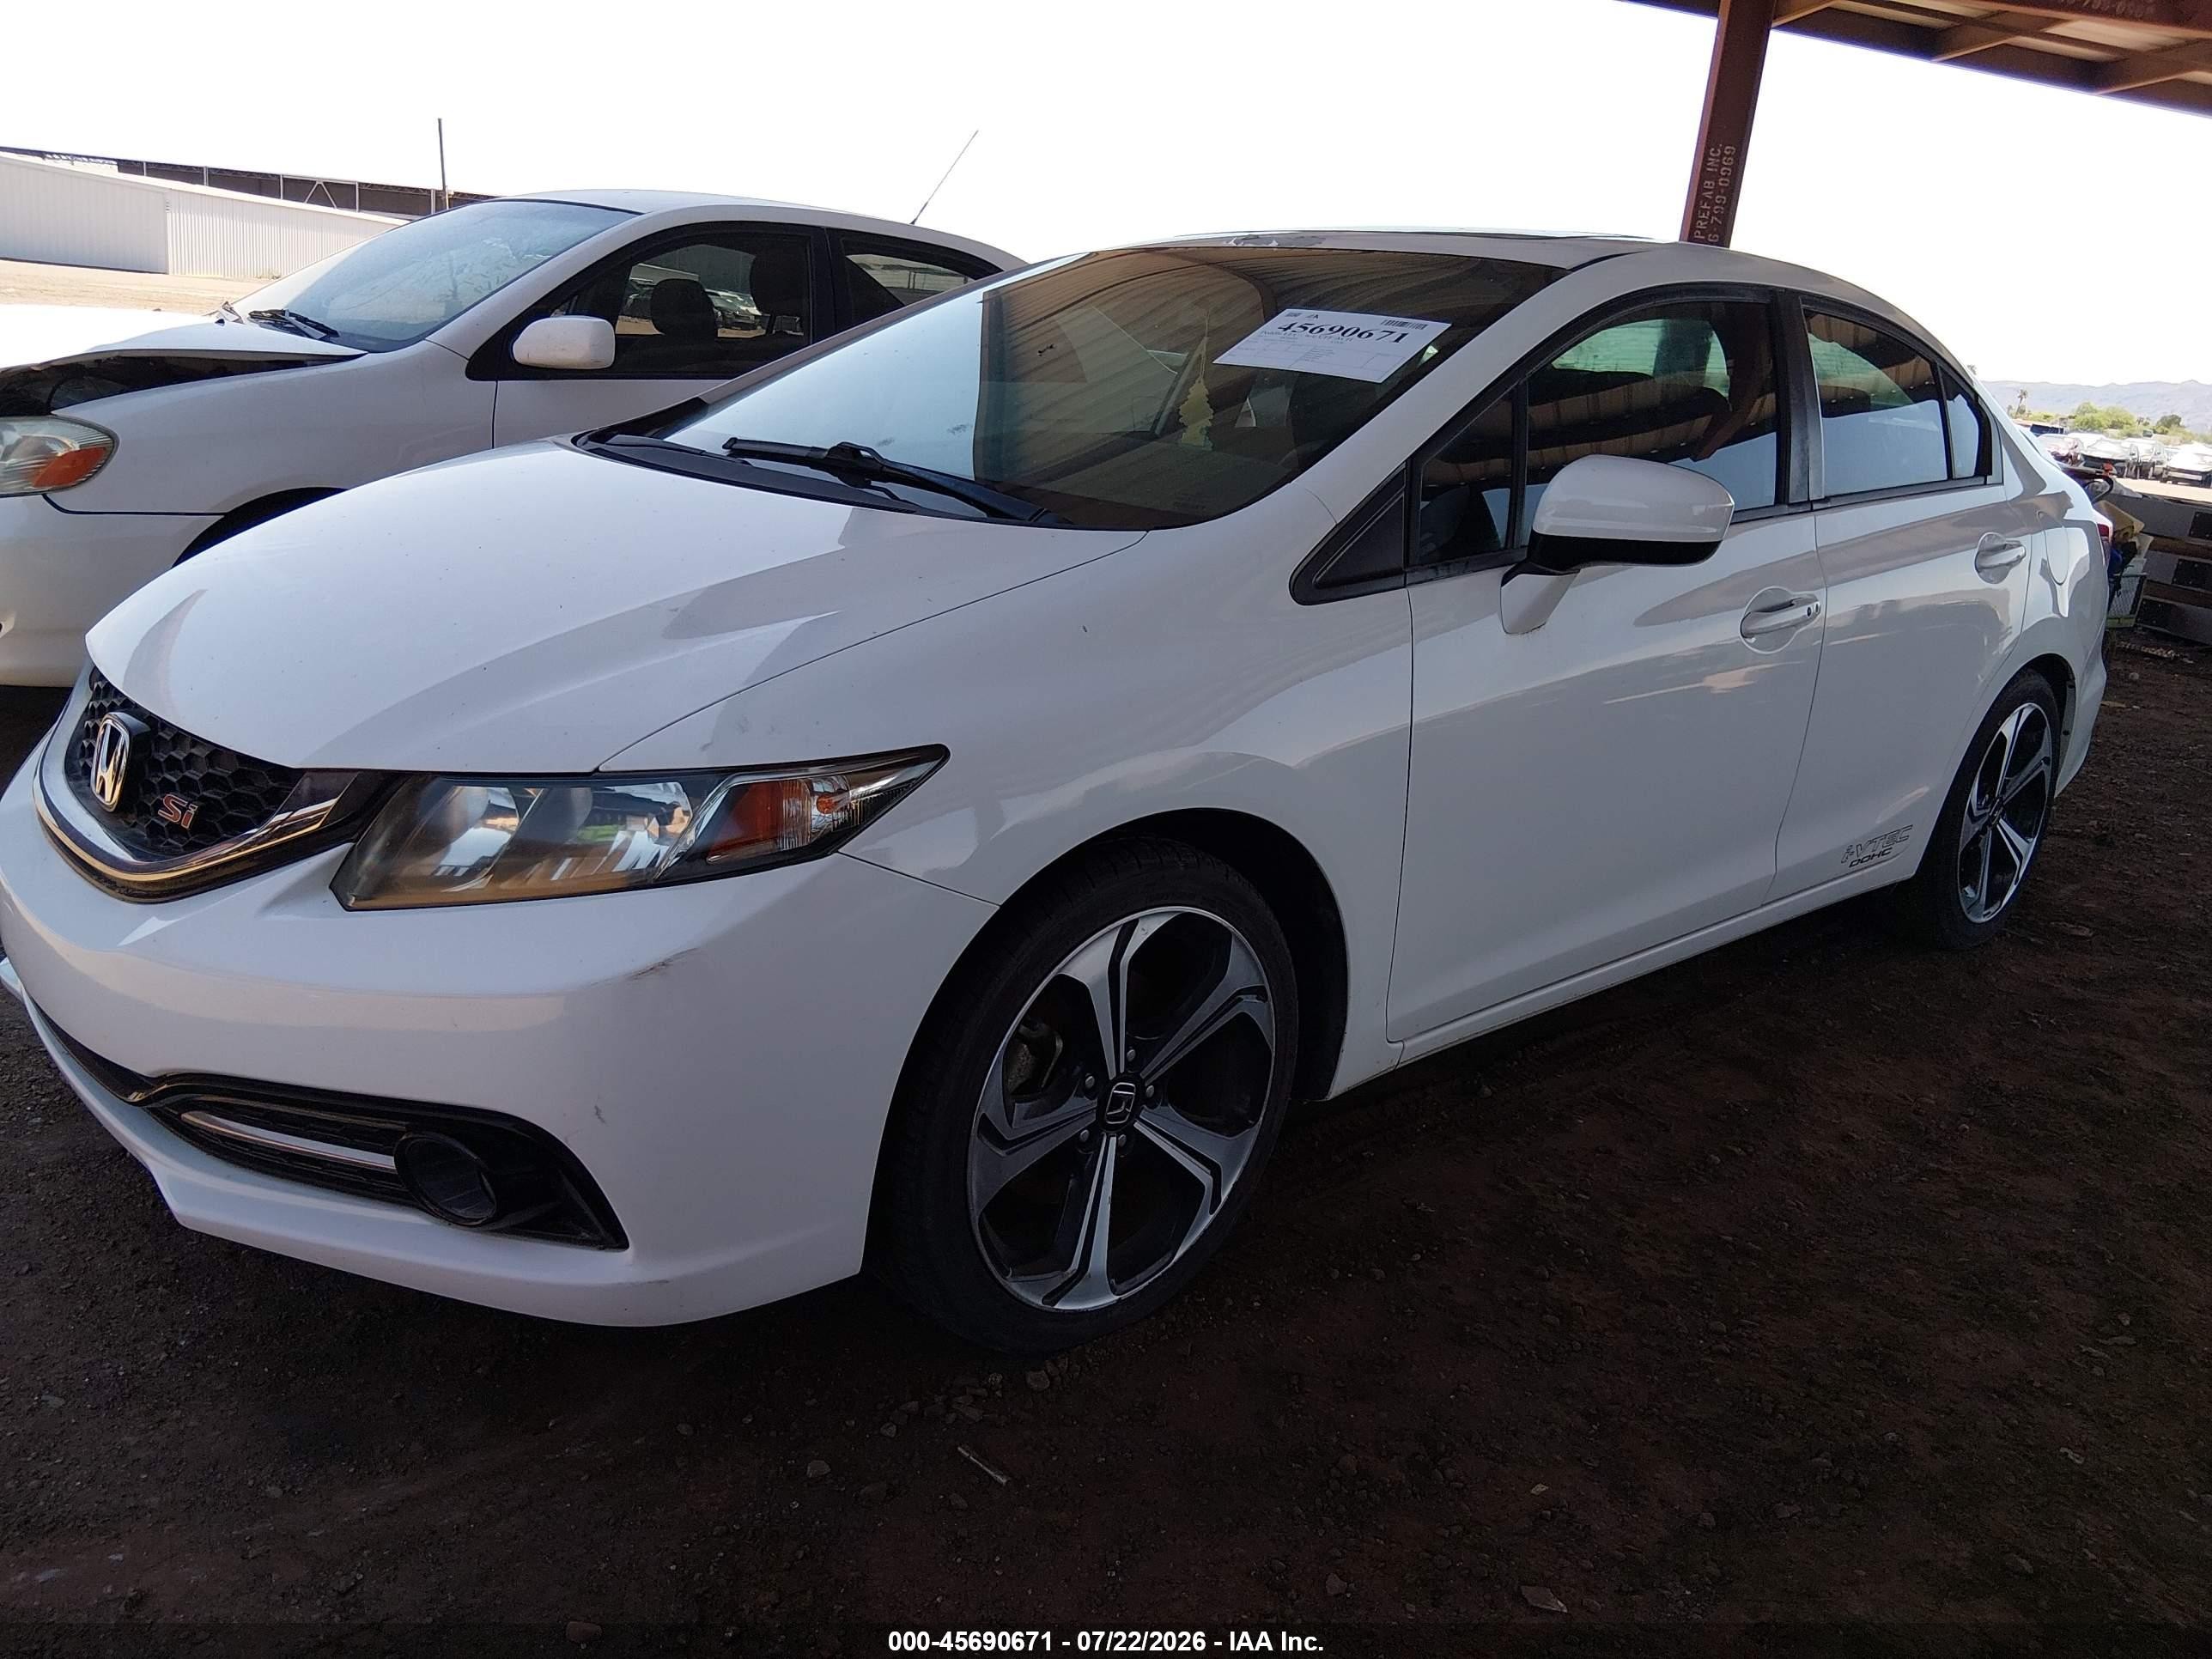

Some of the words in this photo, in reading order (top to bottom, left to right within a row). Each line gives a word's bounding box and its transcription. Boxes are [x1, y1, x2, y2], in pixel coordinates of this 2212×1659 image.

[1694, 180, 1716, 240] PREFAB
[1706, 143, 1723, 173] INC.
[1278, 321, 1409, 343] 45690671
[158, 793, 199, 830] Si
[1848, 847, 1893, 868] DOHC
